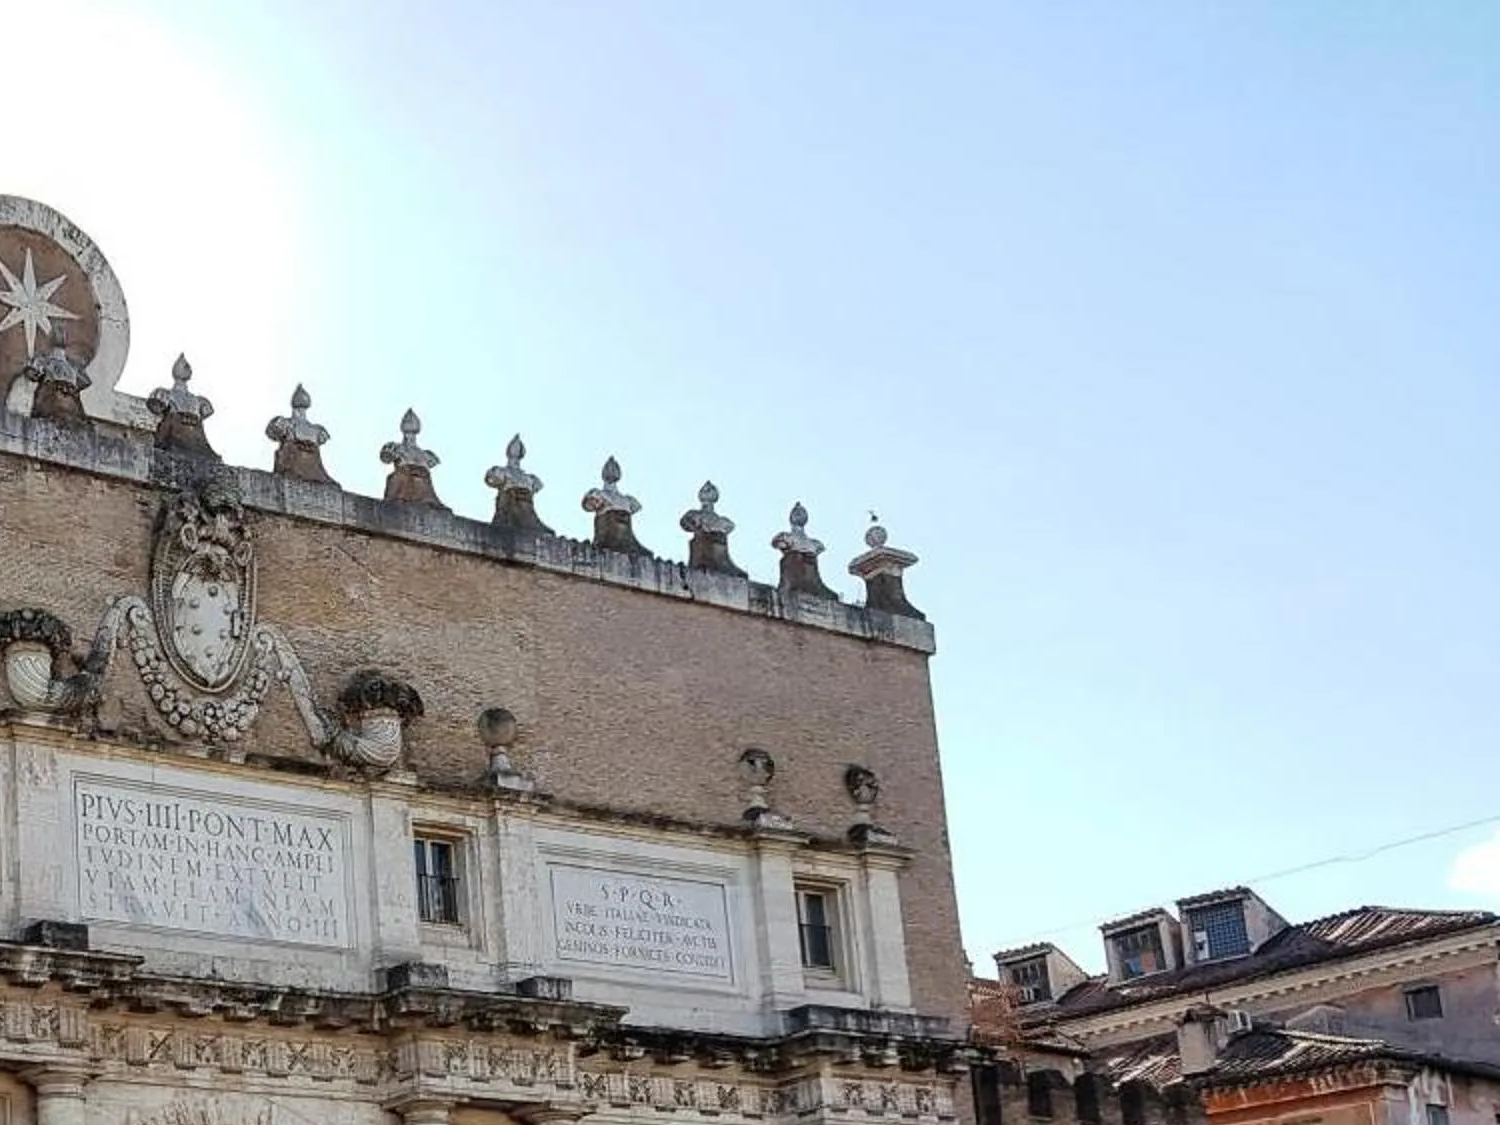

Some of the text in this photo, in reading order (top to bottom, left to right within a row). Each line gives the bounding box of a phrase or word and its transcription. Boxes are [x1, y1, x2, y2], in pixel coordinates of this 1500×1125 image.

[81, 793, 137, 824] PIVS
[188, 808, 265, 842] PONT
[270, 820, 334, 852] MAX
[83, 823, 169, 851] PORTAM
